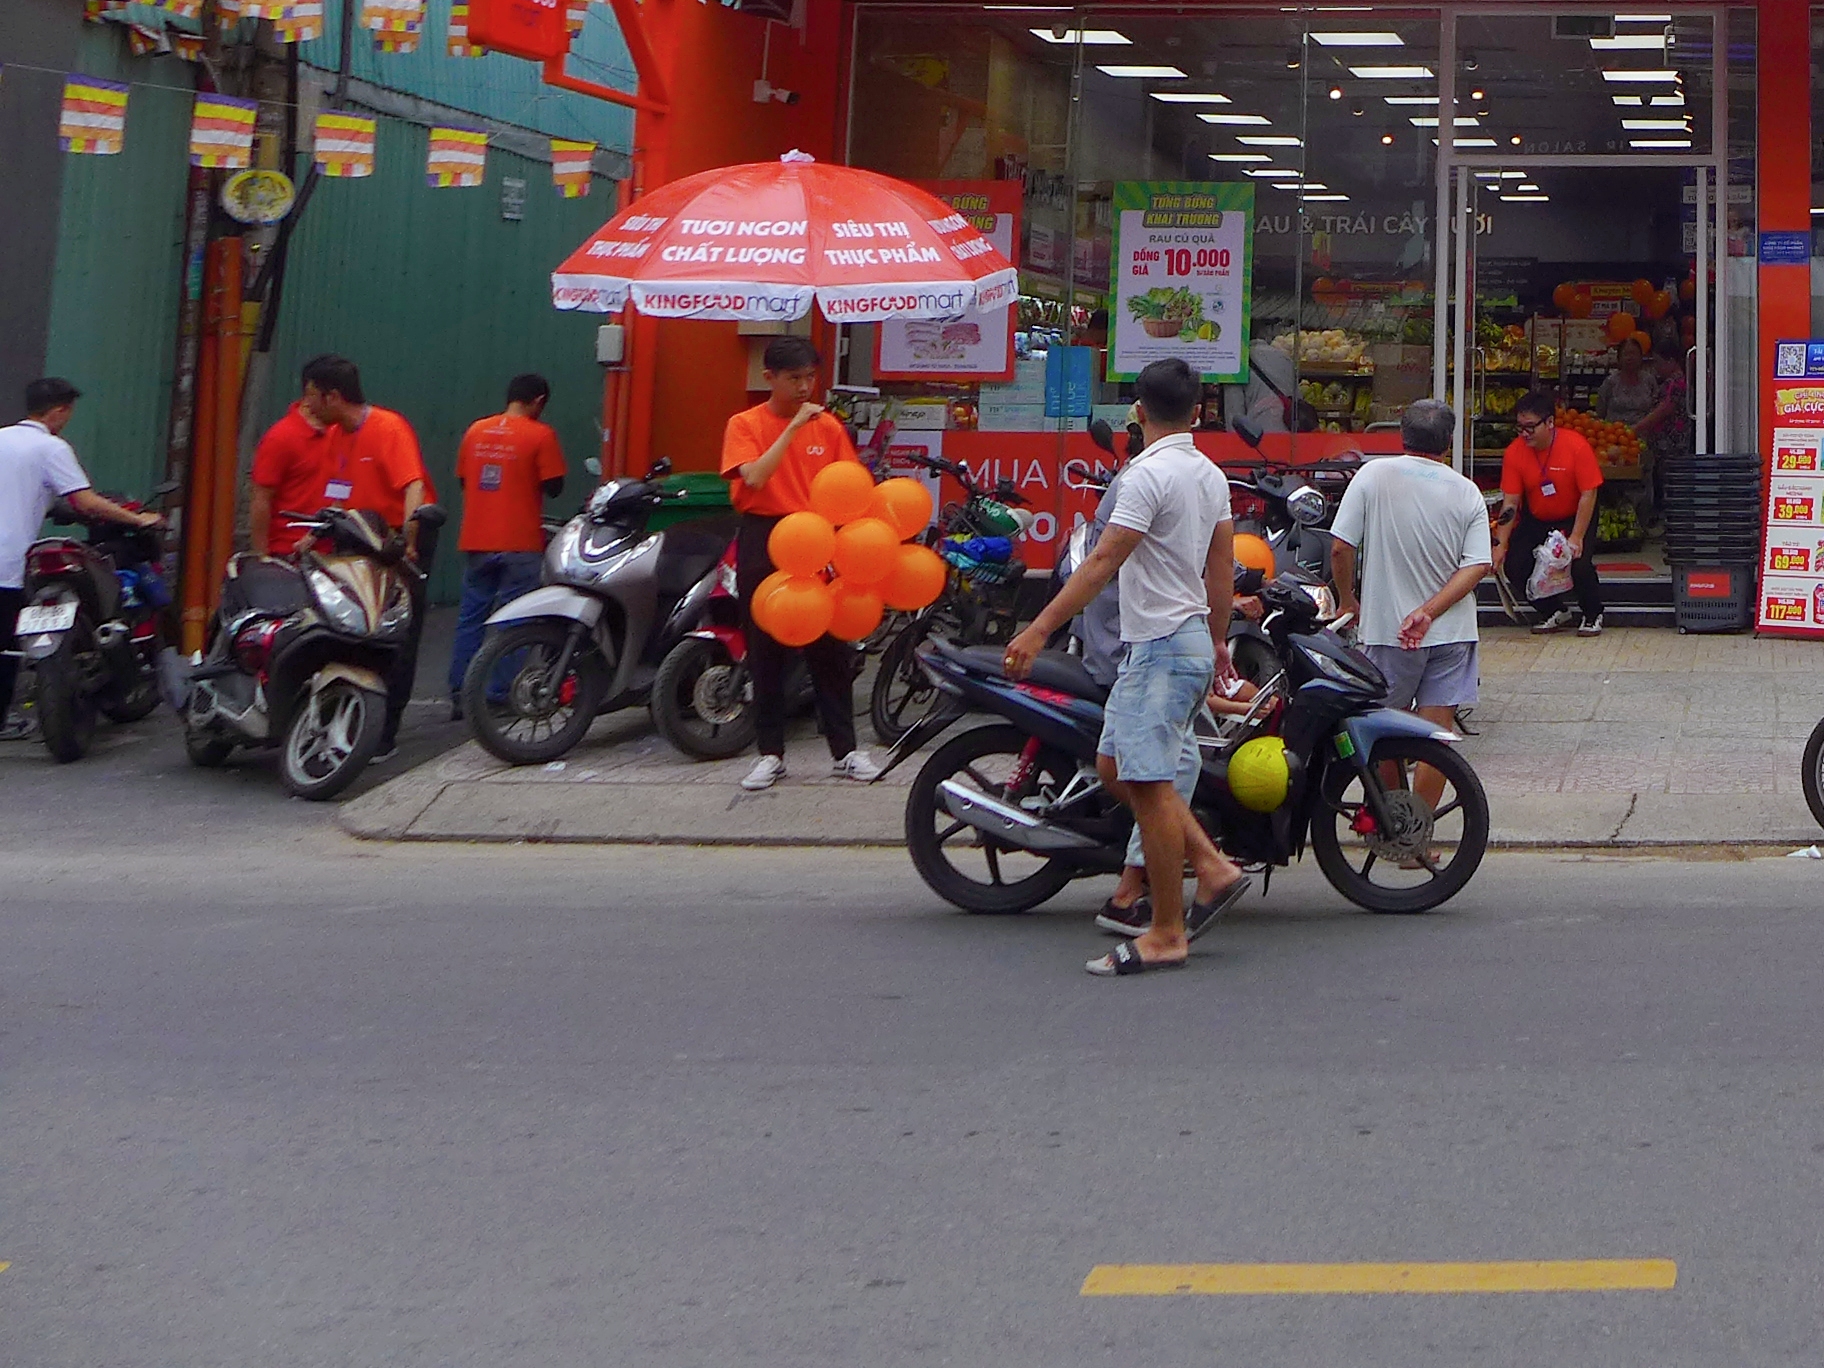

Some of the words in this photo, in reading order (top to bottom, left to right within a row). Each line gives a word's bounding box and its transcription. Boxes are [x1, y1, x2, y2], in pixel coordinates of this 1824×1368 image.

[680, 218, 737, 236] TƯƠI
[741, 219, 808, 237] NGON
[831, 218, 877, 238] SIÊU
[880, 222, 910, 239] THỊ
[1252, 215, 1290, 233] AU
[1321, 209, 1376, 234] TRÁI
[1382, 209, 1428, 234] CÂY
[1149, 235, 1171, 243] RAU
[661, 241, 722, 263] CHẤT
[725, 245, 807, 267] LƯỢNG
[824, 246, 879, 268] THỰC
[881, 240, 942, 264] PHẨM
[1133, 246, 1159, 261] ĐỒNG
[1165, 248, 1230, 277] 10.000
[1132, 264, 1148, 276] GIÁ
[1784, 400, 1803, 414] GIÁ
[961, 458, 1049, 490] MUA
